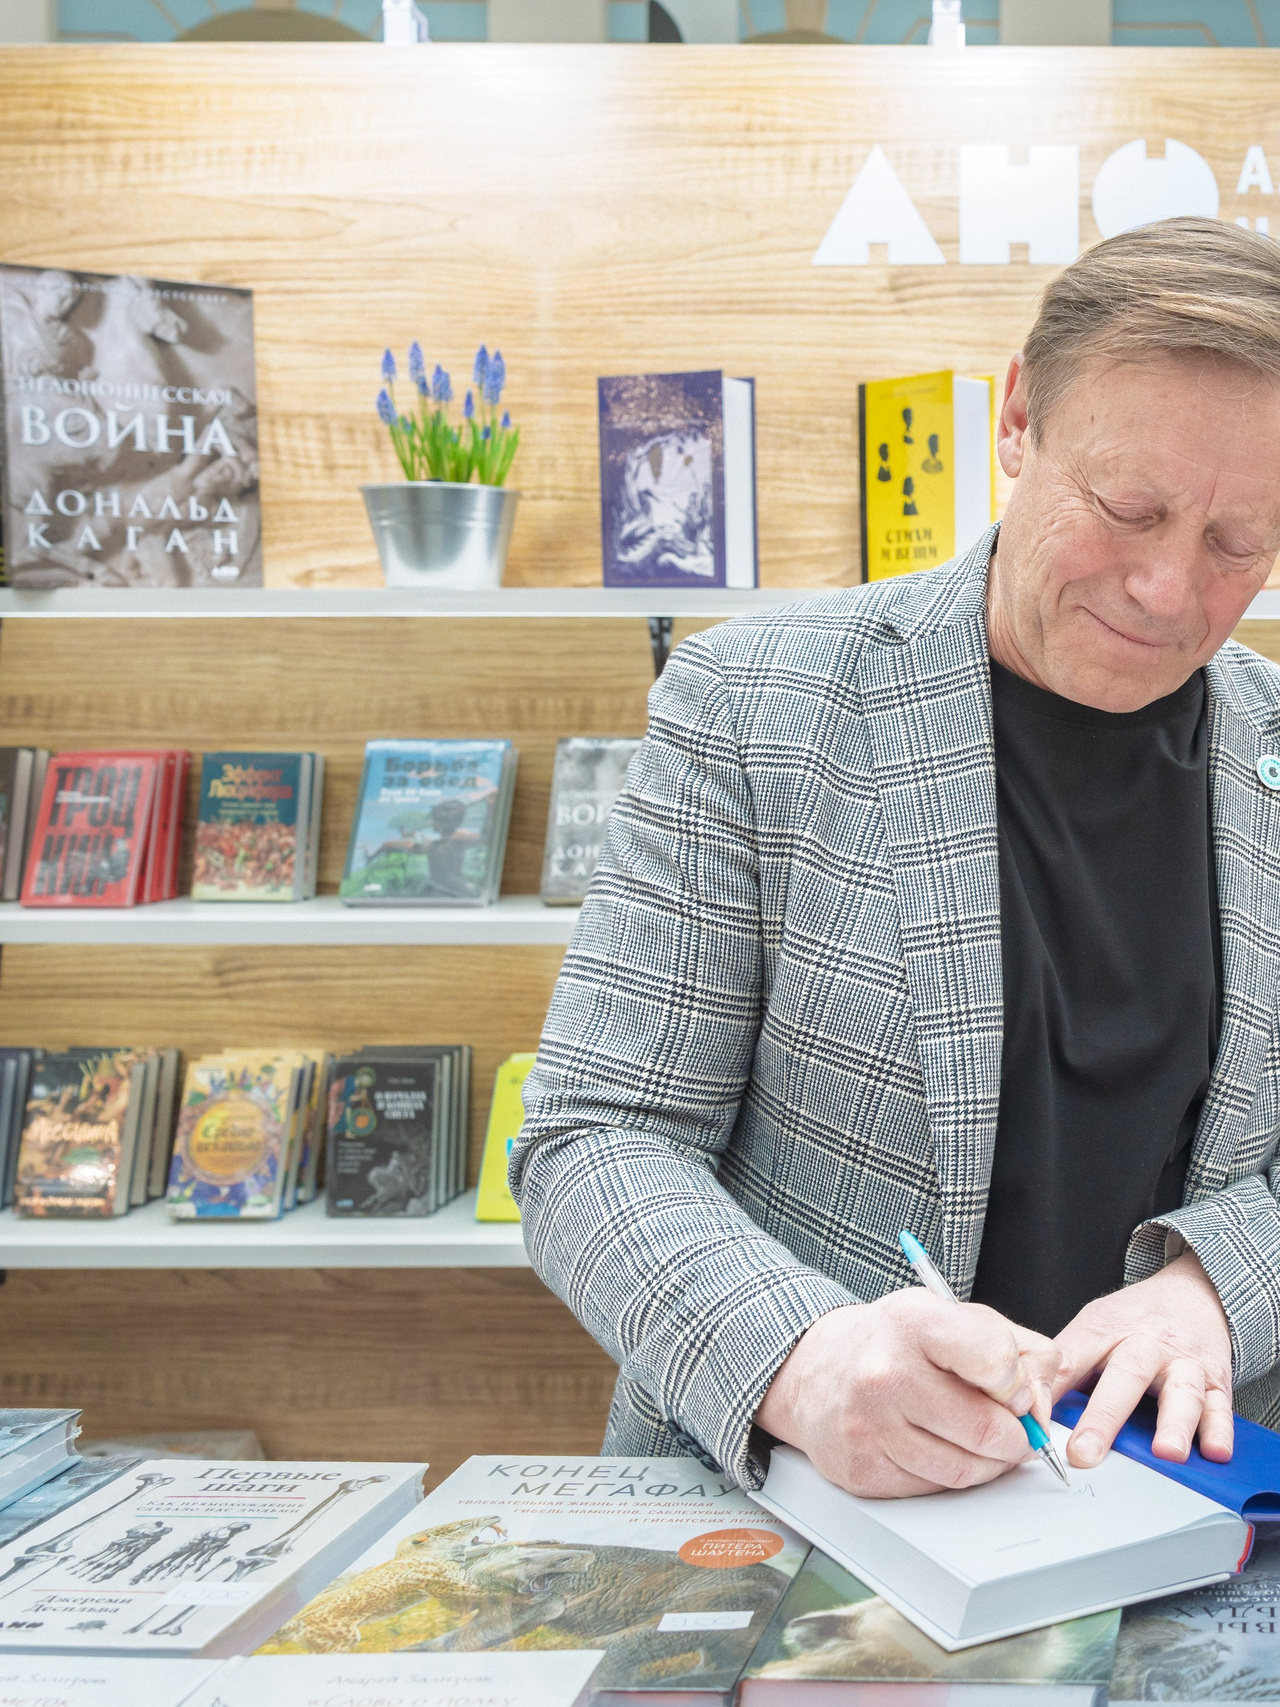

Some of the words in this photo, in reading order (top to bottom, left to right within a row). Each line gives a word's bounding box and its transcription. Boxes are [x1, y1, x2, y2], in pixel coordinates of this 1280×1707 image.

[19, 401, 238, 457] ВОЙНА
[24, 488, 240, 523] ДОНАЛЬД
[27, 523, 240, 555] КАГАН
[194, 1467, 342, 1483] Первые
[487, 1463, 651, 1482] КОНЕЦ
[197, 1483, 301, 1493] шаги
[511, 1482, 751, 1497] МЕГАФАУ
[568, 1508, 643, 1516] МАМОНТОВ,
[647, 1508, 733, 1516] САБЛЕЗУБЫХ
[690, 1549, 766, 1557] ШАУТЕНА
[35, 1595, 134, 1605] Джереми
[22, 1604, 121, 1614] Десильва
